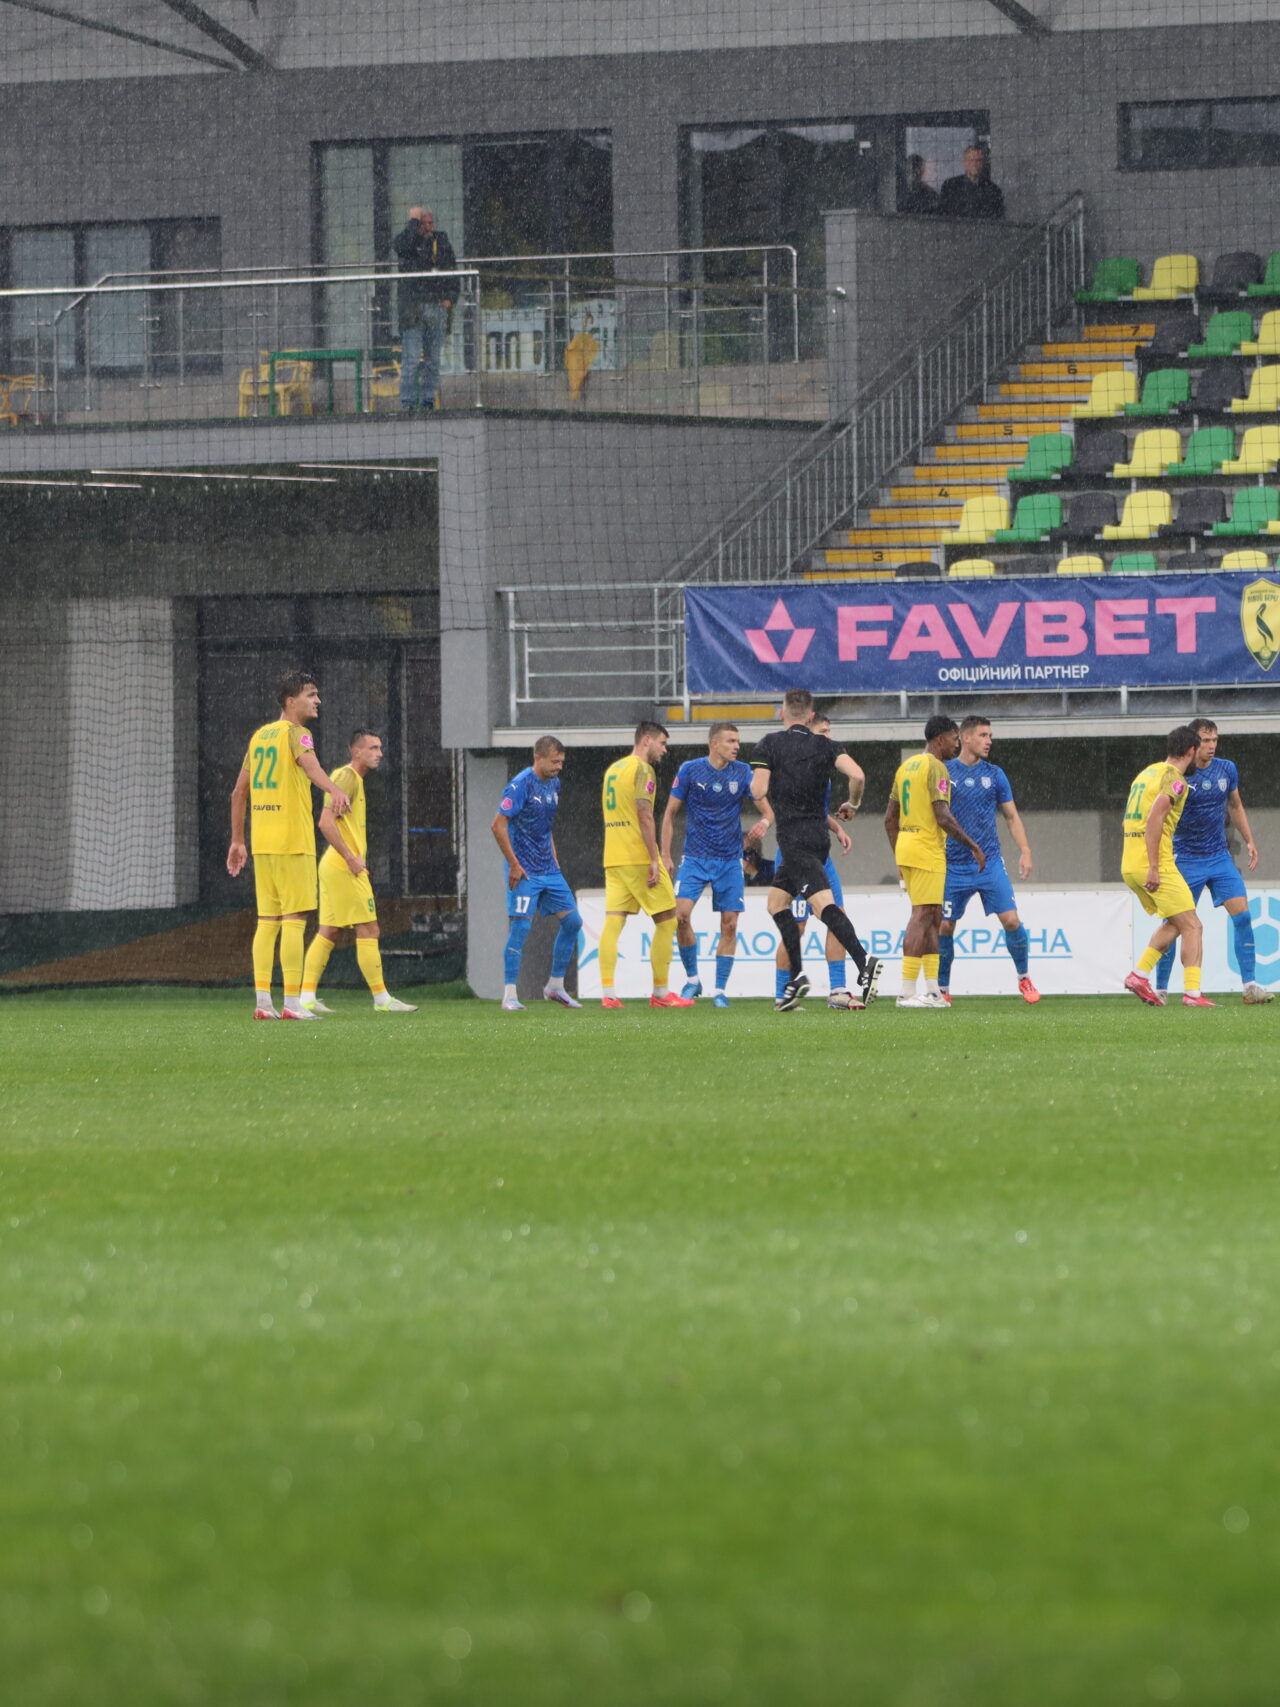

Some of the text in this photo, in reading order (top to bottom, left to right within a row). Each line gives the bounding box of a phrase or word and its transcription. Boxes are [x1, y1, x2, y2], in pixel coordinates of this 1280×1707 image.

[1130, 325, 1140, 336] 7
[1067, 364, 1078, 375] 6
[1003, 425, 1013, 436] 5
[938, 488, 949, 498] 4
[873, 551, 884, 562] 3
[836, 597, 1217, 662] FAVBET
[938, 664, 1090, 682] ОФІЦІЙНИЙ ПАРТНЕР
[252, 745, 278, 789] 22
[606, 775, 617, 810] 5
[1125, 783, 1146, 820] 21
[515, 896, 530, 913] 17
[791, 900, 807, 917] 18
